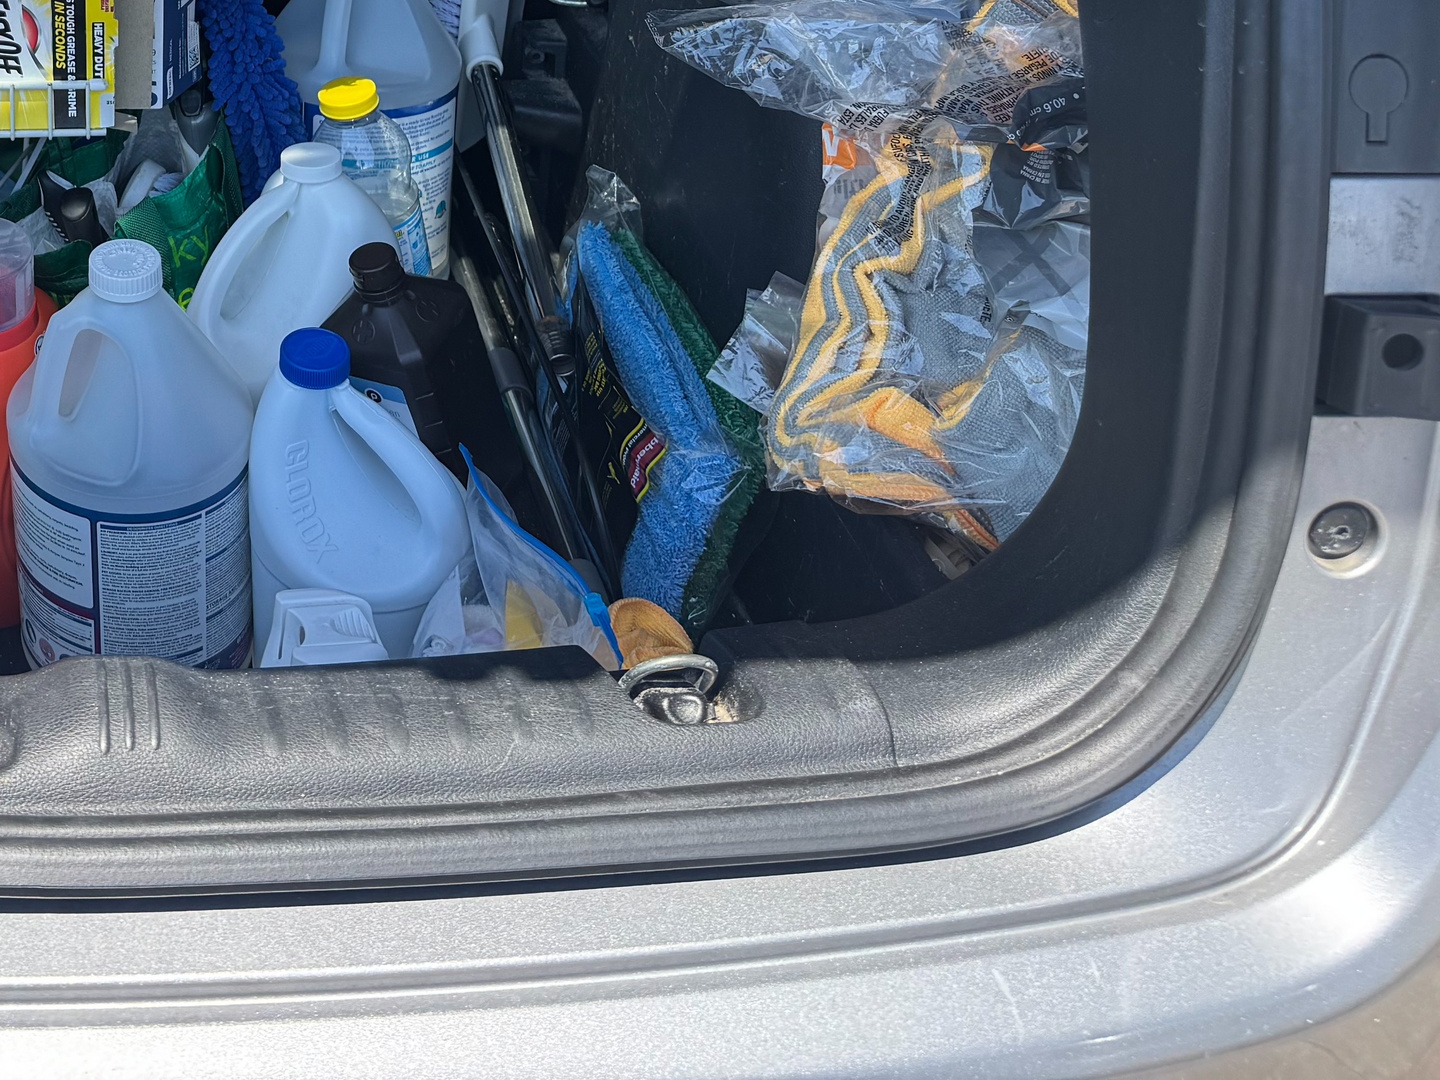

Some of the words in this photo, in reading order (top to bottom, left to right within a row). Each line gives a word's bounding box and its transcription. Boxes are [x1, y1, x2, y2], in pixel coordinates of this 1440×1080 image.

[54, 1, 64, 12] IN
[65, 4, 75, 34] TOUGH
[55, 15, 66, 69] SECONDS
[67, 36, 76, 73] GREASE
[94, 23, 103, 55] HEAVY
[94, 56, 103, 79] DUT
[1043, 96, 1067, 113] 40.6
[285, 439, 340, 565] CLOROX
